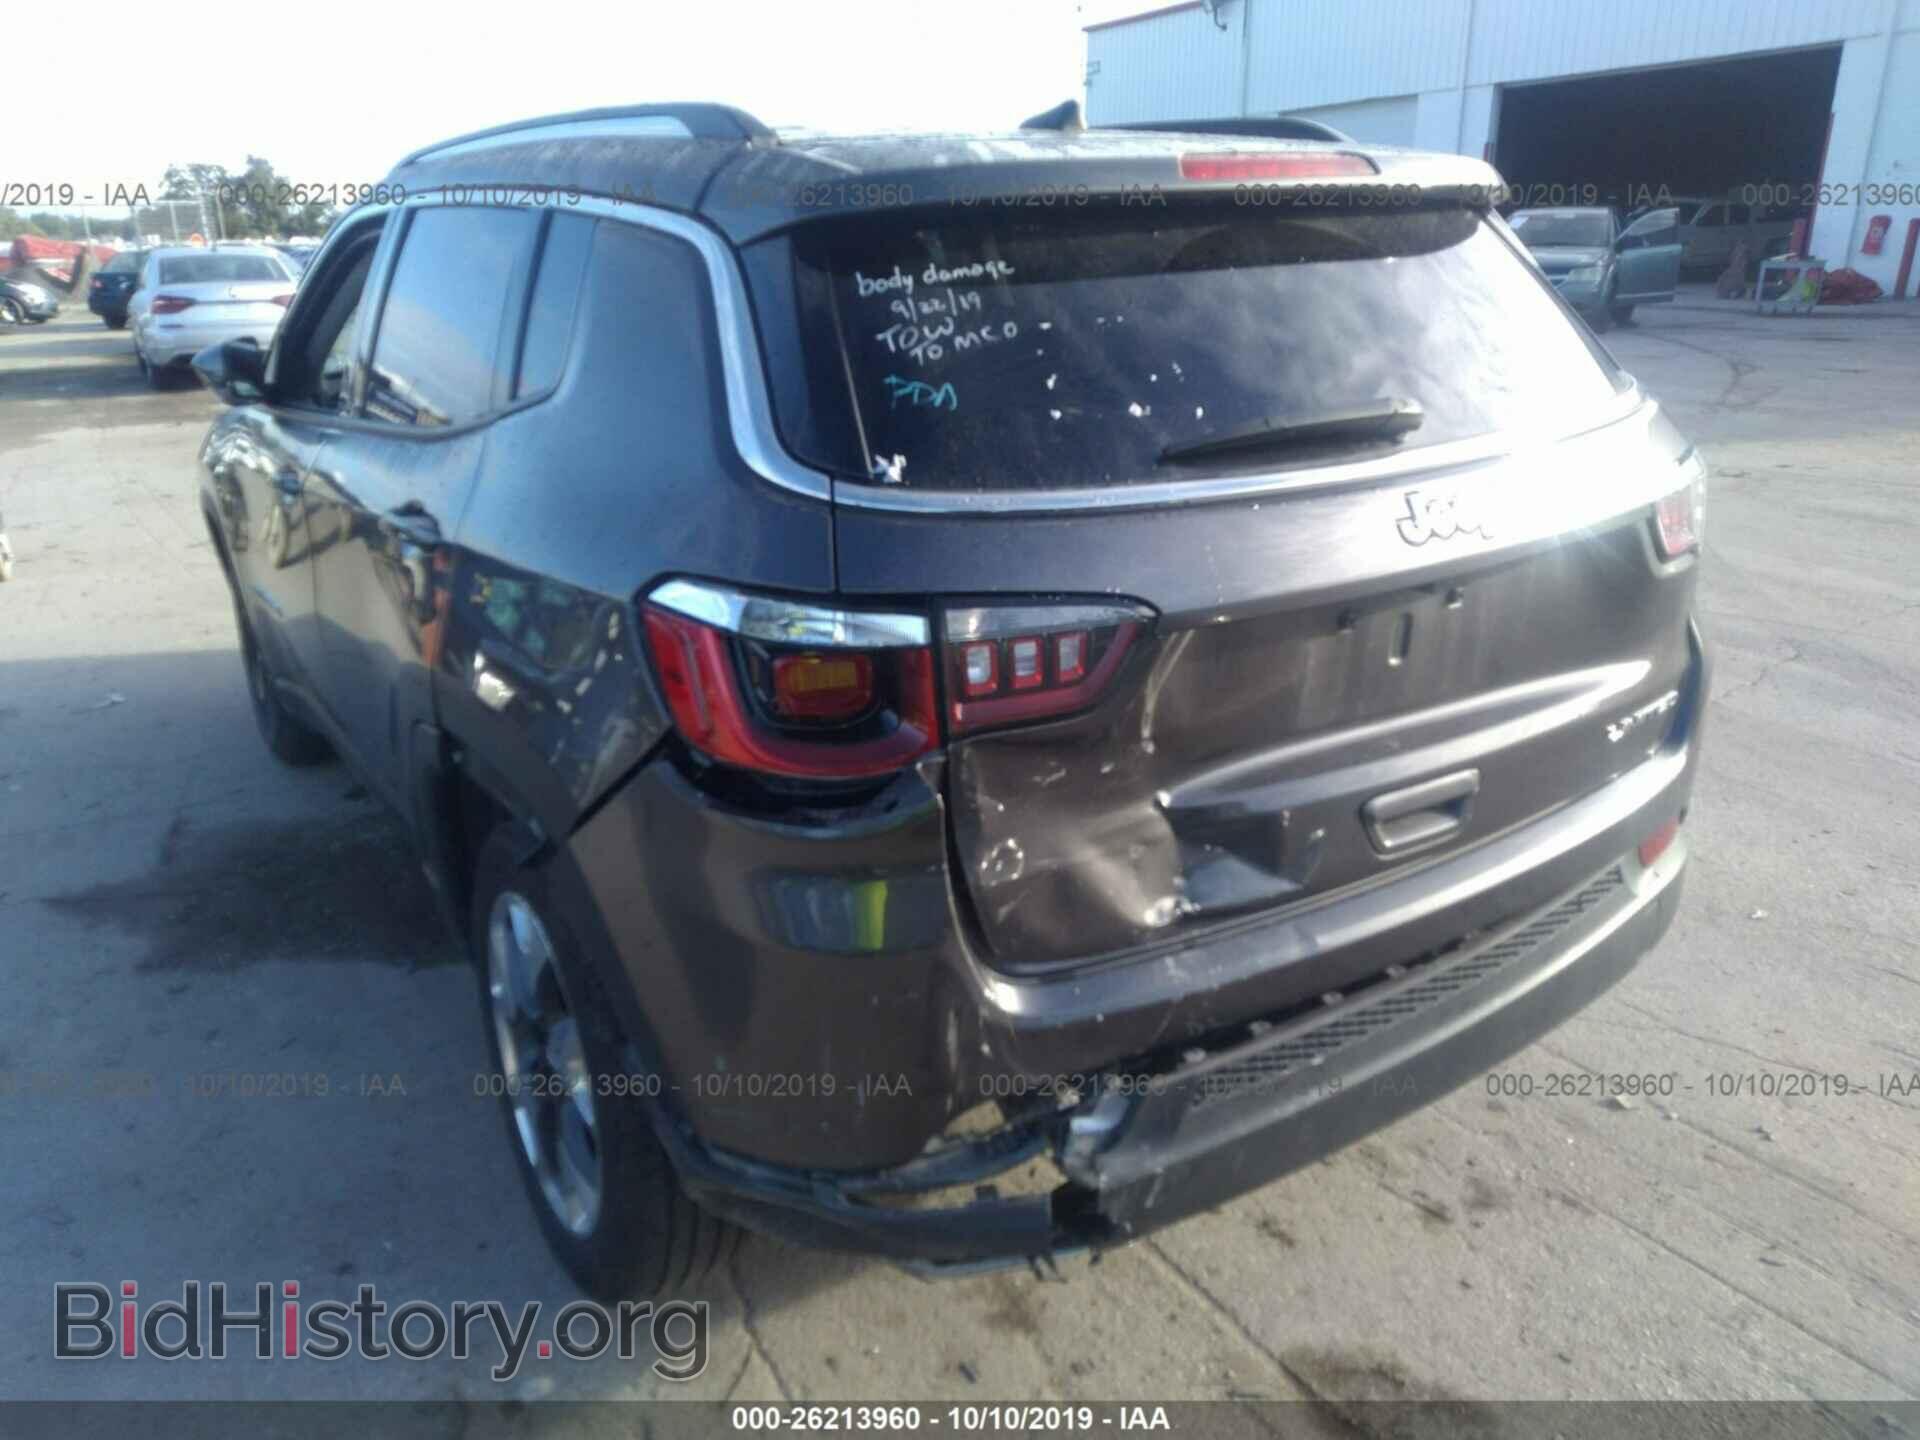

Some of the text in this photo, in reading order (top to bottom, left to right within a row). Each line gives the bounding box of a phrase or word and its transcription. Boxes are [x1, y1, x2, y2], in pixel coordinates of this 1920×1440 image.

[856, 260, 1015, 297] body damage
[876, 317, 954, 353] TOW
[910, 342, 944, 367] TO
